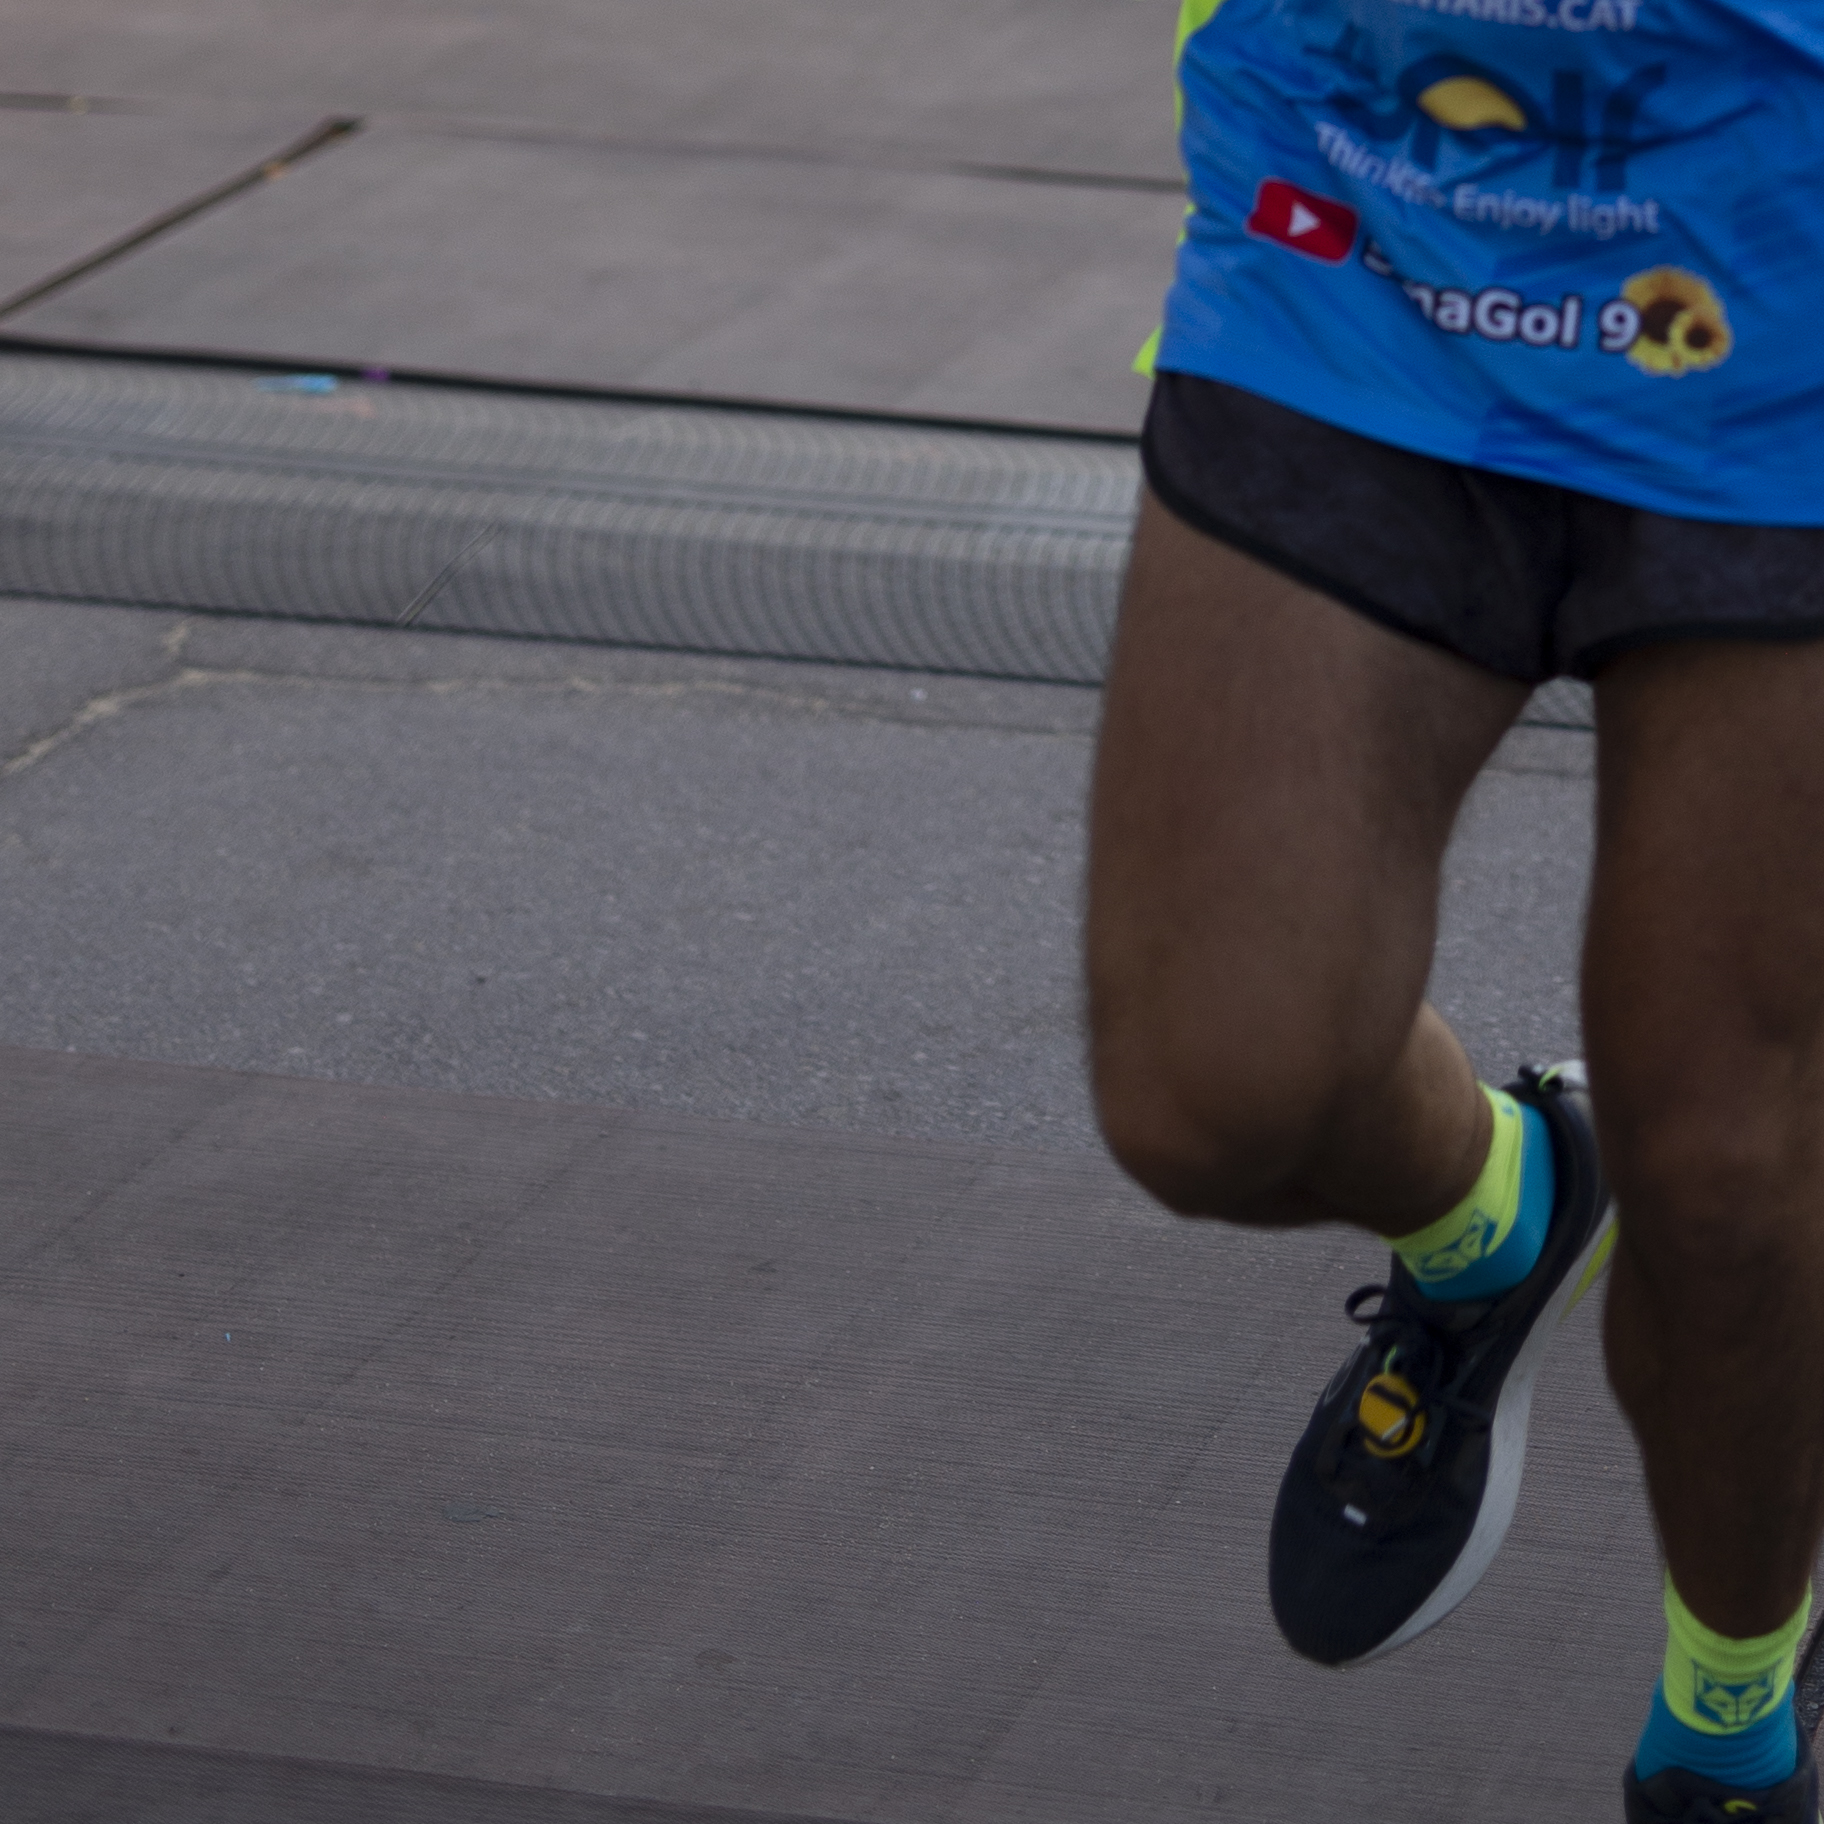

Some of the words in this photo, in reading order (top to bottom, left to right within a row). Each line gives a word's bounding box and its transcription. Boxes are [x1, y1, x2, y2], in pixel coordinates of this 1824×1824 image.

[1453, 183, 1563, 237] Enjoy
[1566, 192, 1661, 241] light
[1599, 298, 1642, 353] 9
